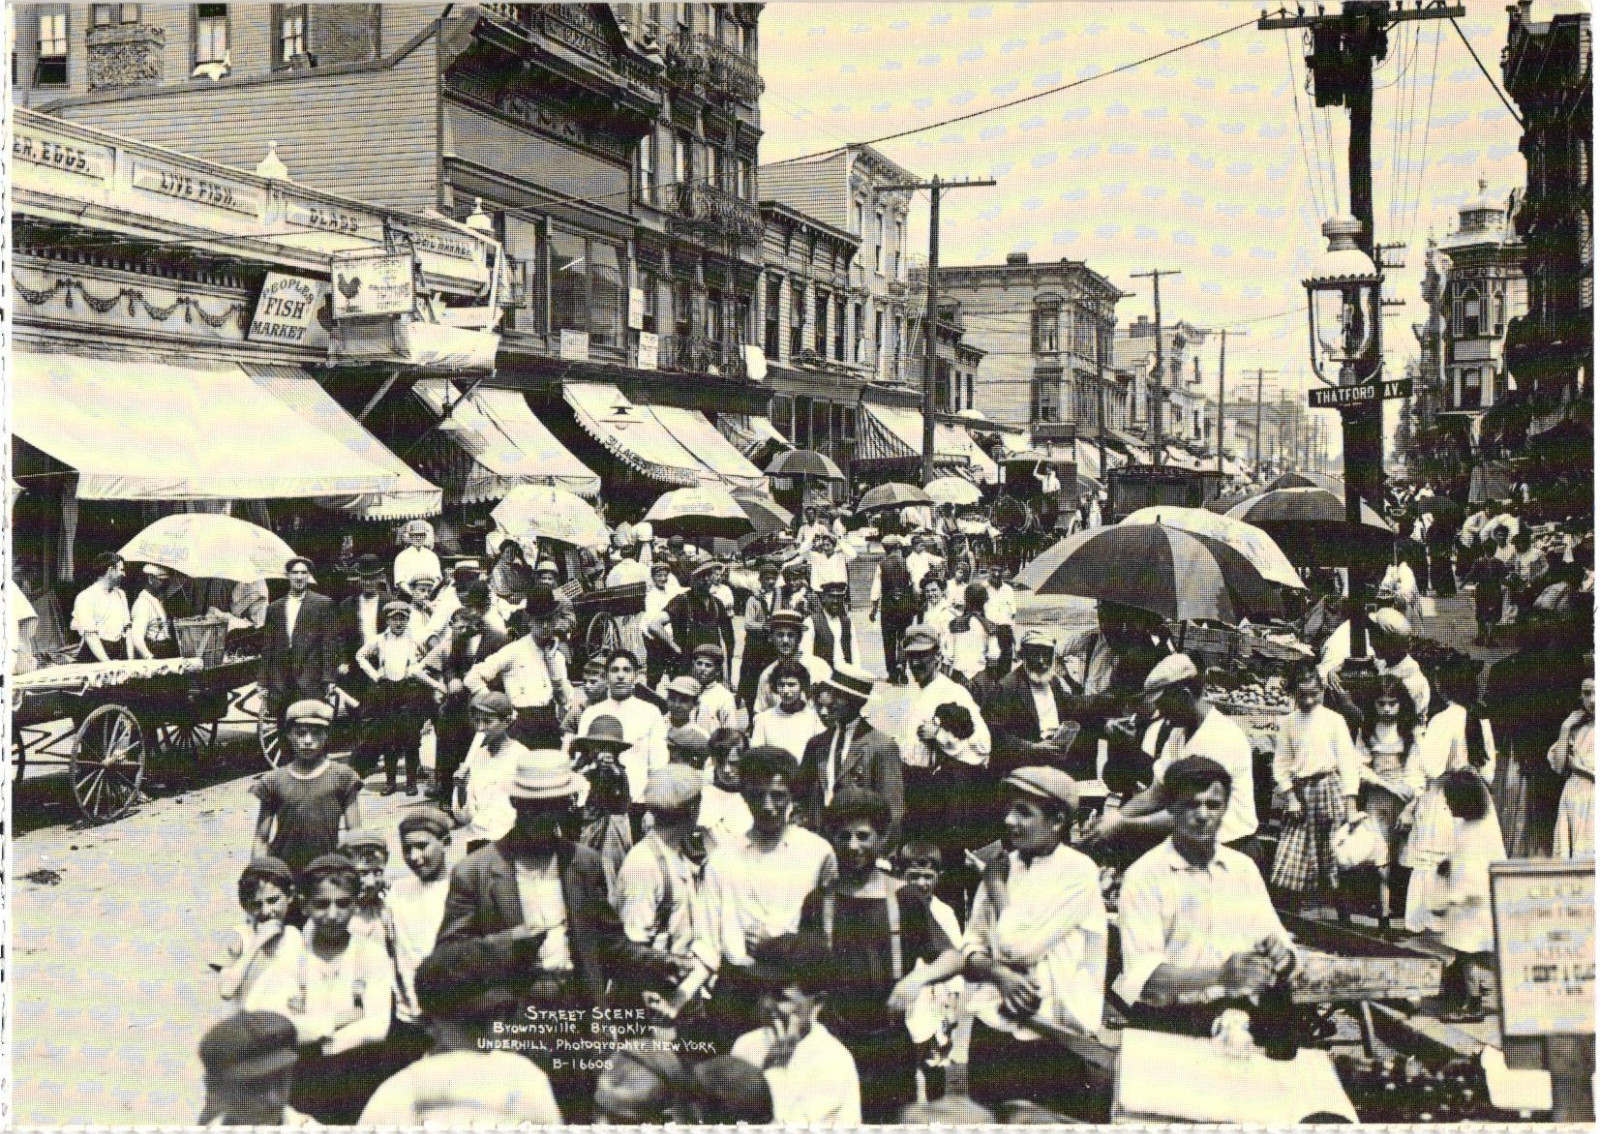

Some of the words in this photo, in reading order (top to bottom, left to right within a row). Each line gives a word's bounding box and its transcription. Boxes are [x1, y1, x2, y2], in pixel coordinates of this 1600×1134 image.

[161, 172, 193, 195] LIVE
[264, 296, 306, 319] FISH
[250, 320, 307, 340] MARKET
[1315, 385, 1375, 404] THATFORD
